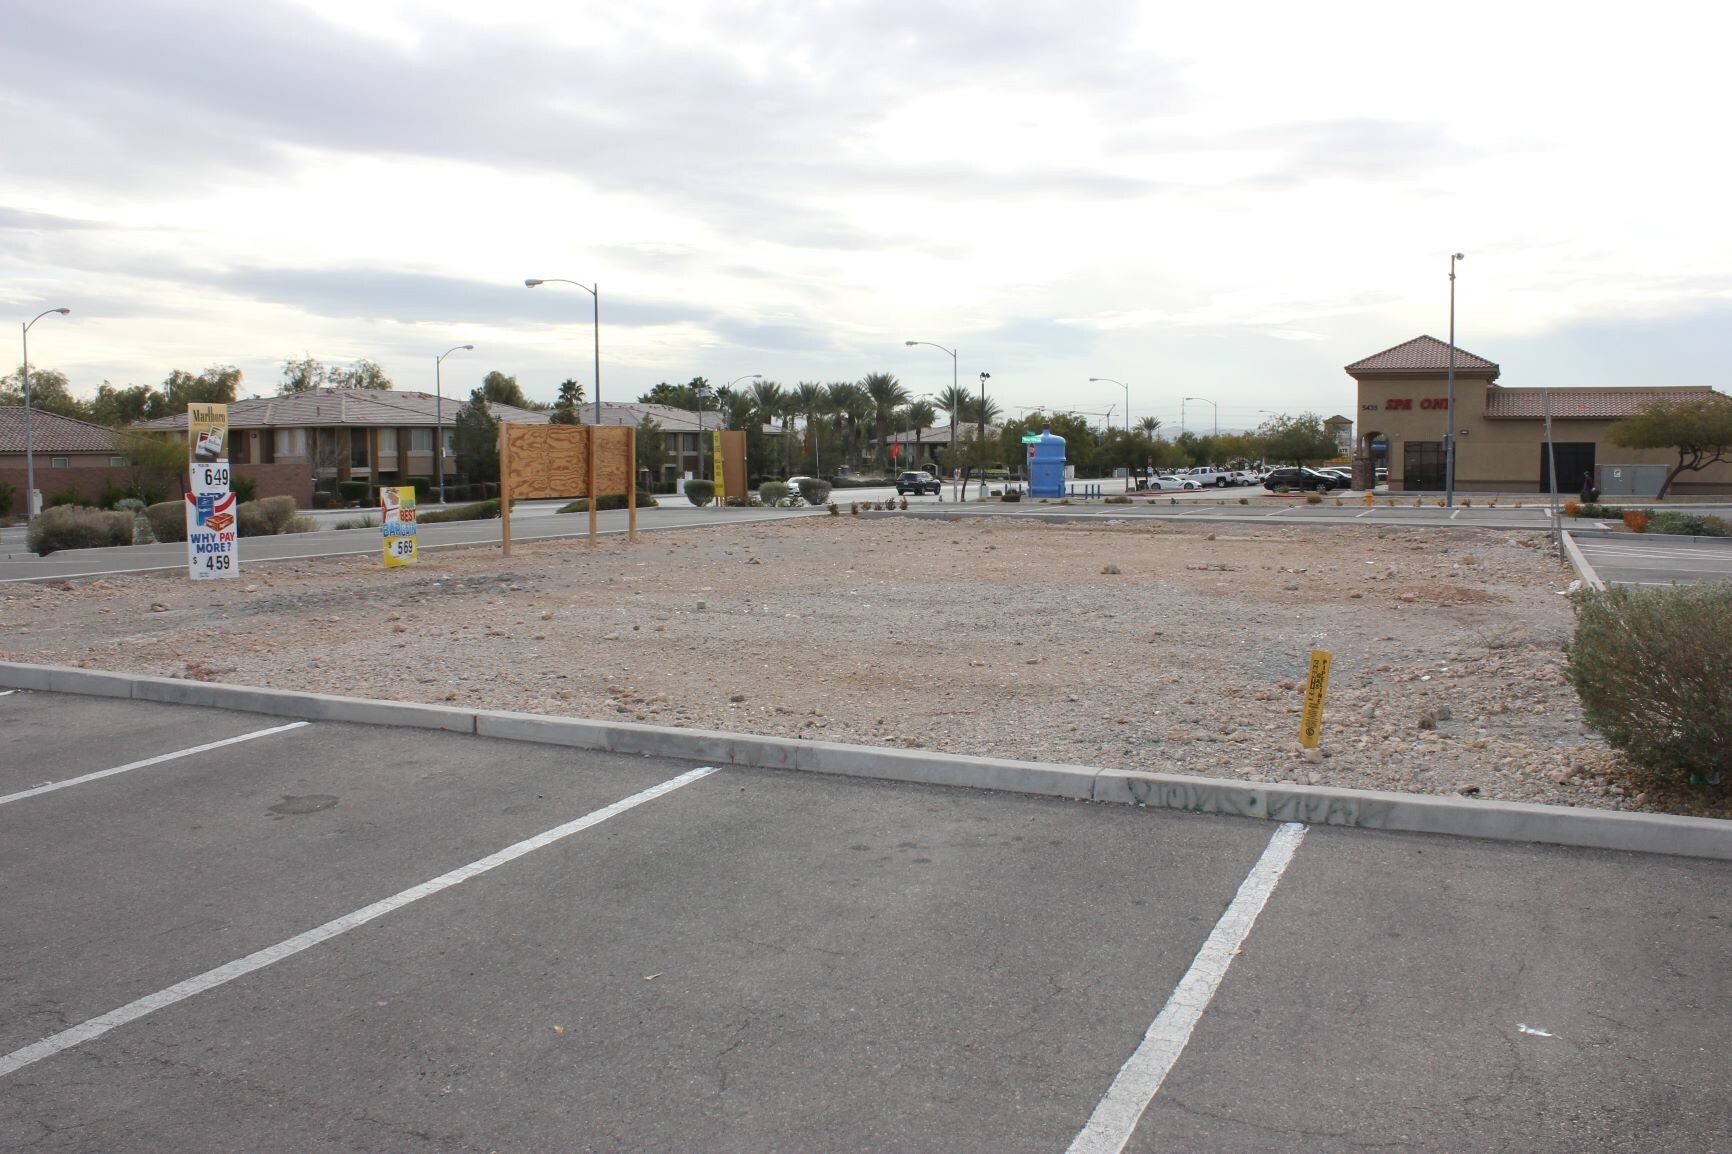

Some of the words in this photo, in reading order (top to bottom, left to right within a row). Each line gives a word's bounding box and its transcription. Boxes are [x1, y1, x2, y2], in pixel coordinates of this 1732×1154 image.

[1385, 399, 1412, 410] SPA
[193, 406, 226, 422] Marlboro
[400, 509, 416, 522] BEST
[190, 534, 216, 544] WHY
[219, 532, 235, 542] PAY
[196, 542, 231, 554] MORE?
[398, 540, 413, 555] 569
[206, 554, 230, 571] 459
